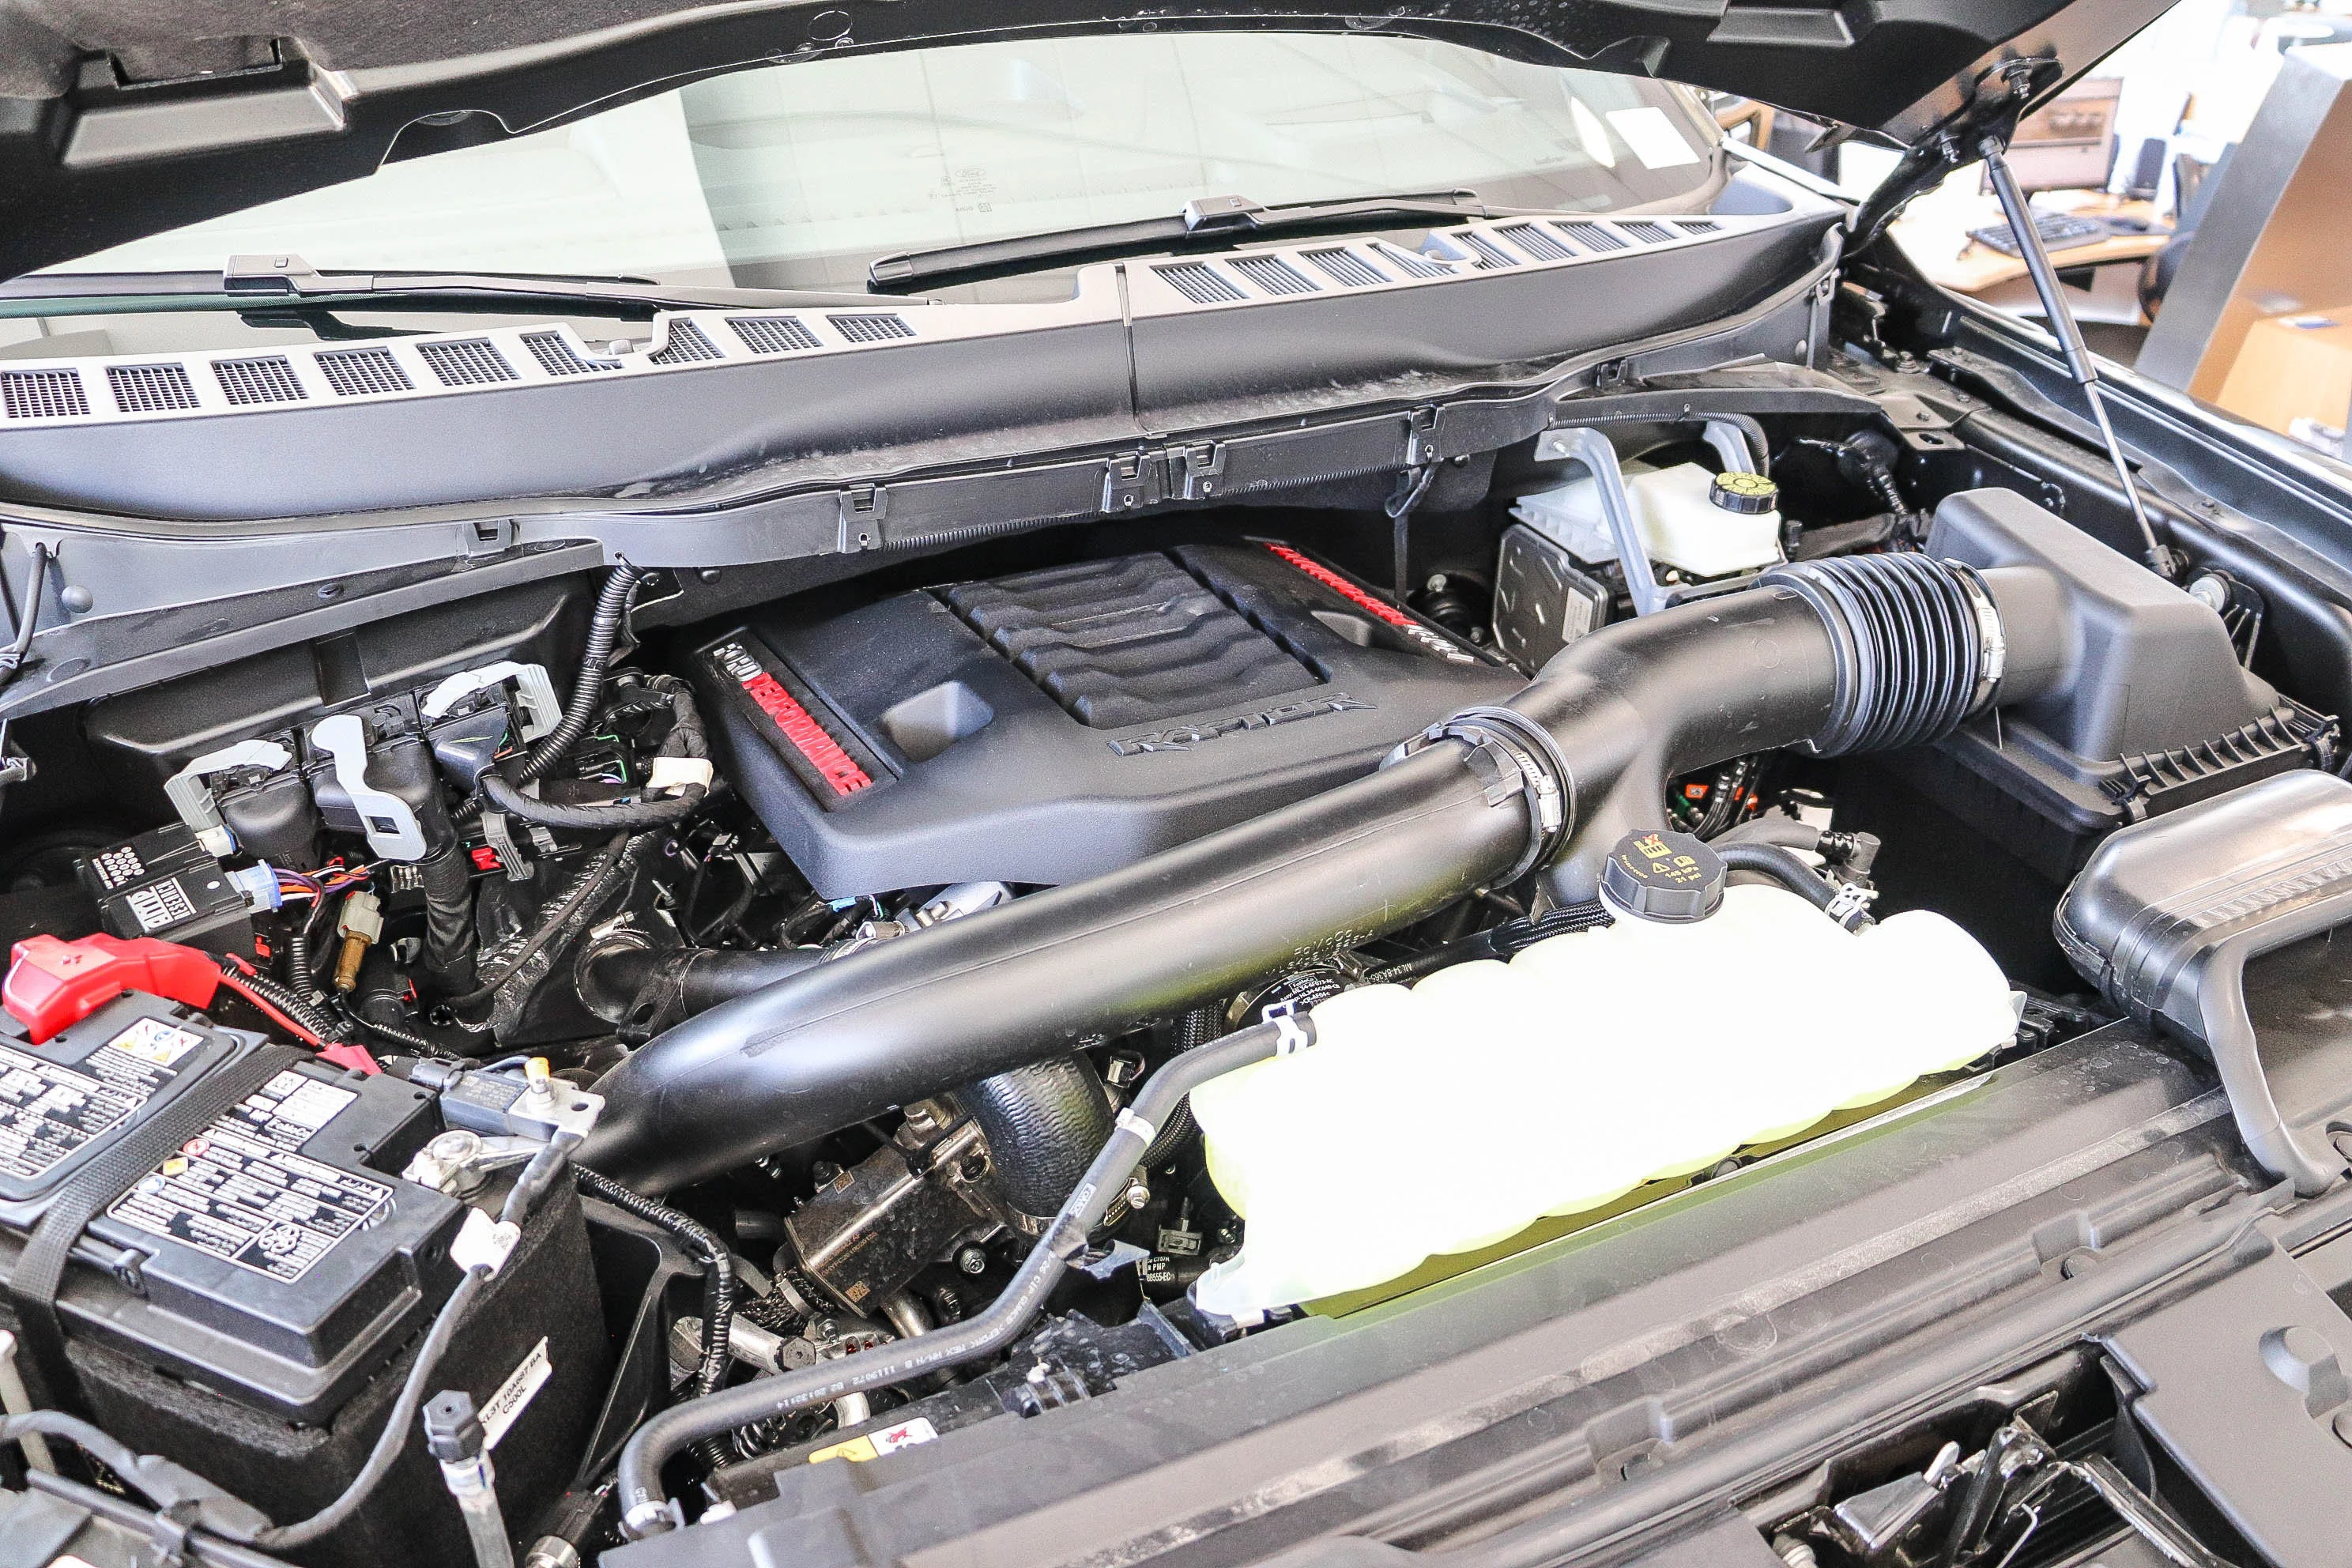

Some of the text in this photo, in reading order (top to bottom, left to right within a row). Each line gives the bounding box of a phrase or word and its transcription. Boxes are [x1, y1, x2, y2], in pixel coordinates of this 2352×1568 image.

[713, 641, 873, 797] FORD PERFORMANCE
[155, 880, 190, 921] RESEARCH
[1292, 976, 1314, 988] FoMoCo
